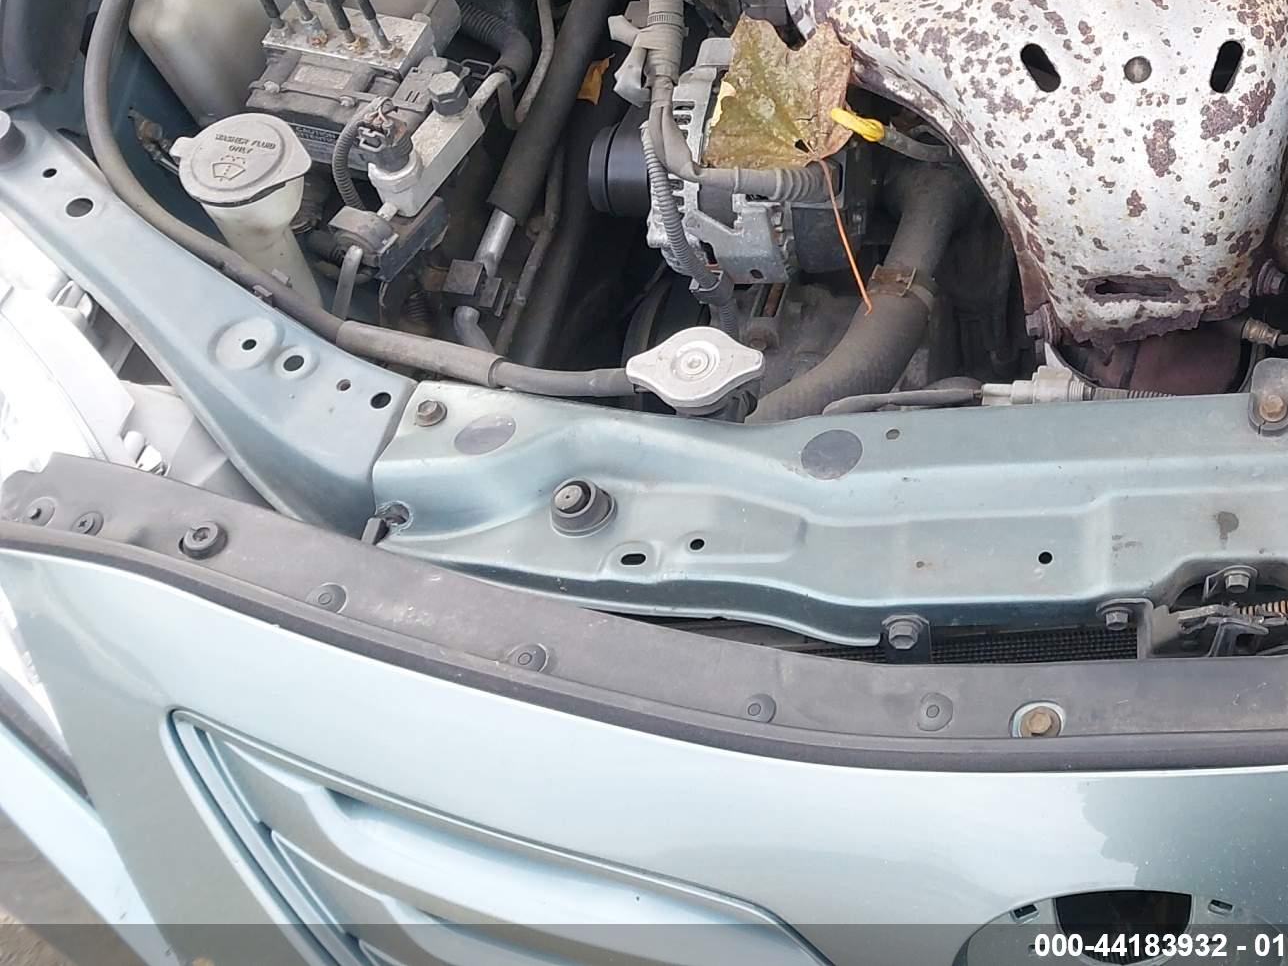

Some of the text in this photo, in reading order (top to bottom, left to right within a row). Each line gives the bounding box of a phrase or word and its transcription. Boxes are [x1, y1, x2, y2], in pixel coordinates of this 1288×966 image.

[215, 133, 276, 150] WASHER FLUID
[228, 145, 253, 154] ONLY
